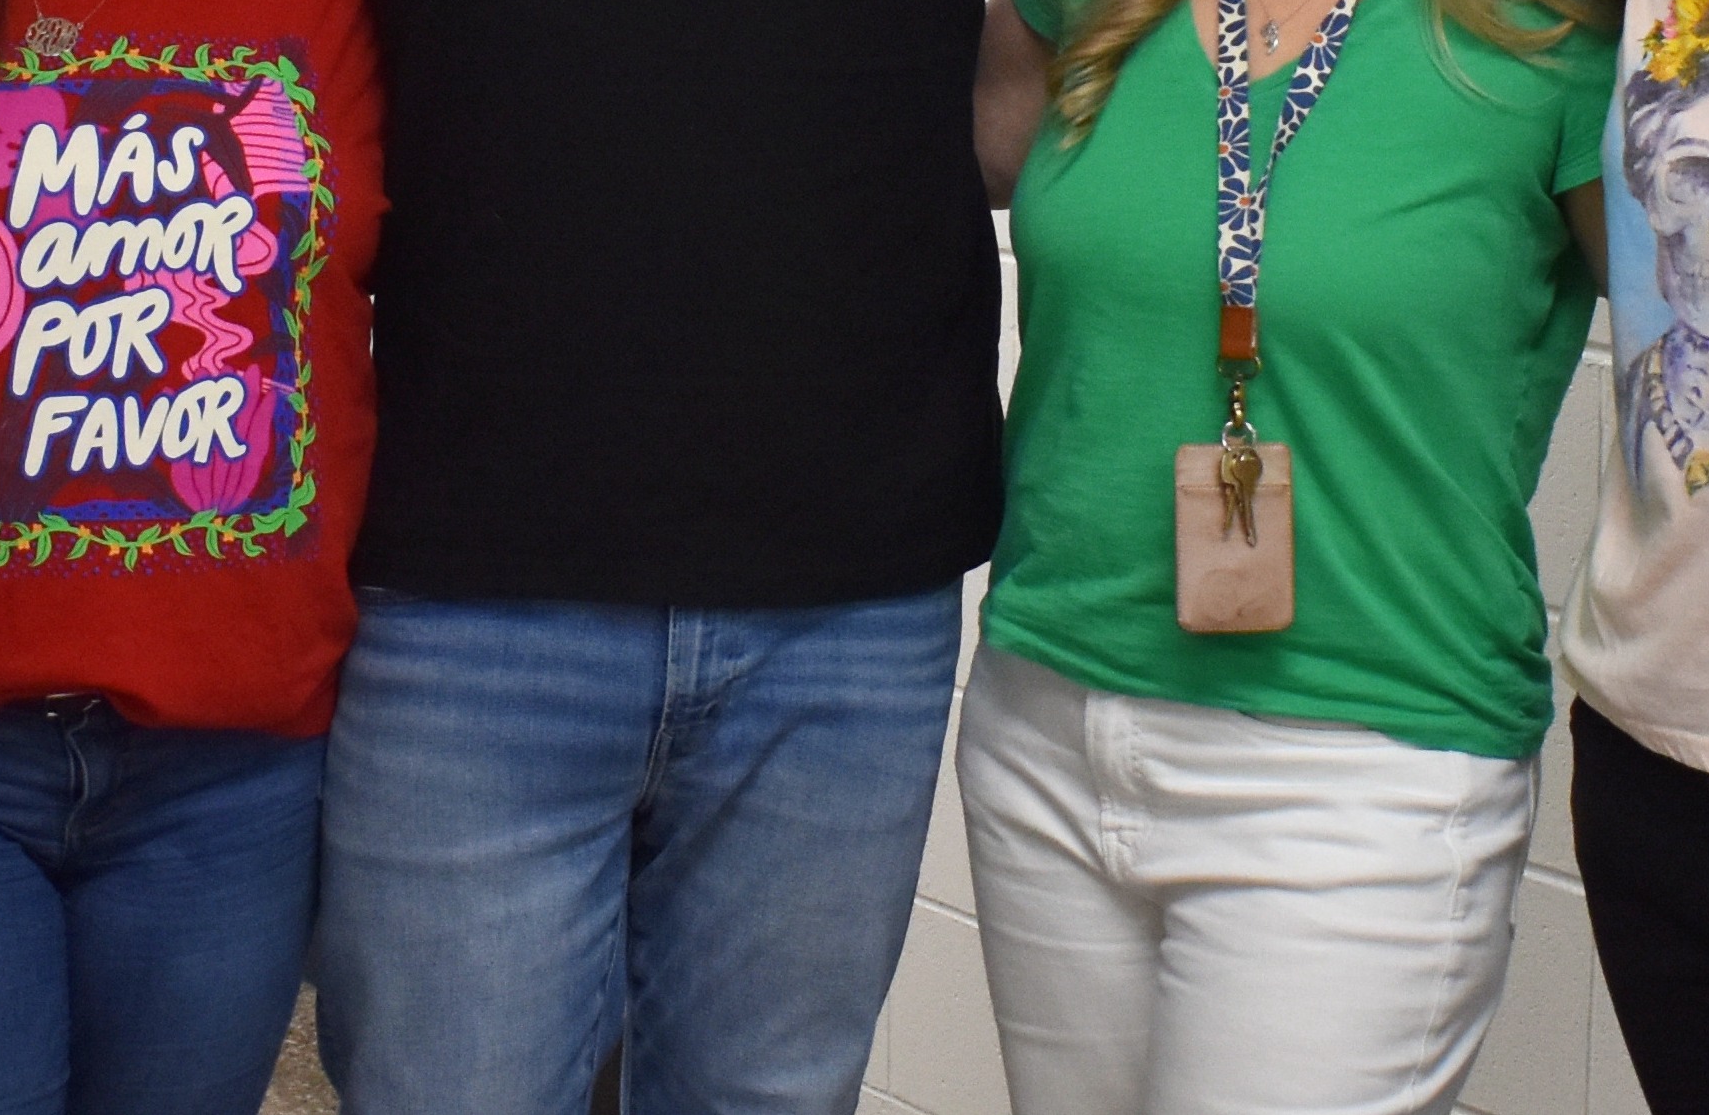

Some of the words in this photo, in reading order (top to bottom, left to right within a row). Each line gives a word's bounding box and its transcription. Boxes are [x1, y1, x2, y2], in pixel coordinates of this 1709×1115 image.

[9, 113, 204, 229] MÁS
[12, 288, 170, 396] POR
[24, 378, 247, 477] FAVOR
